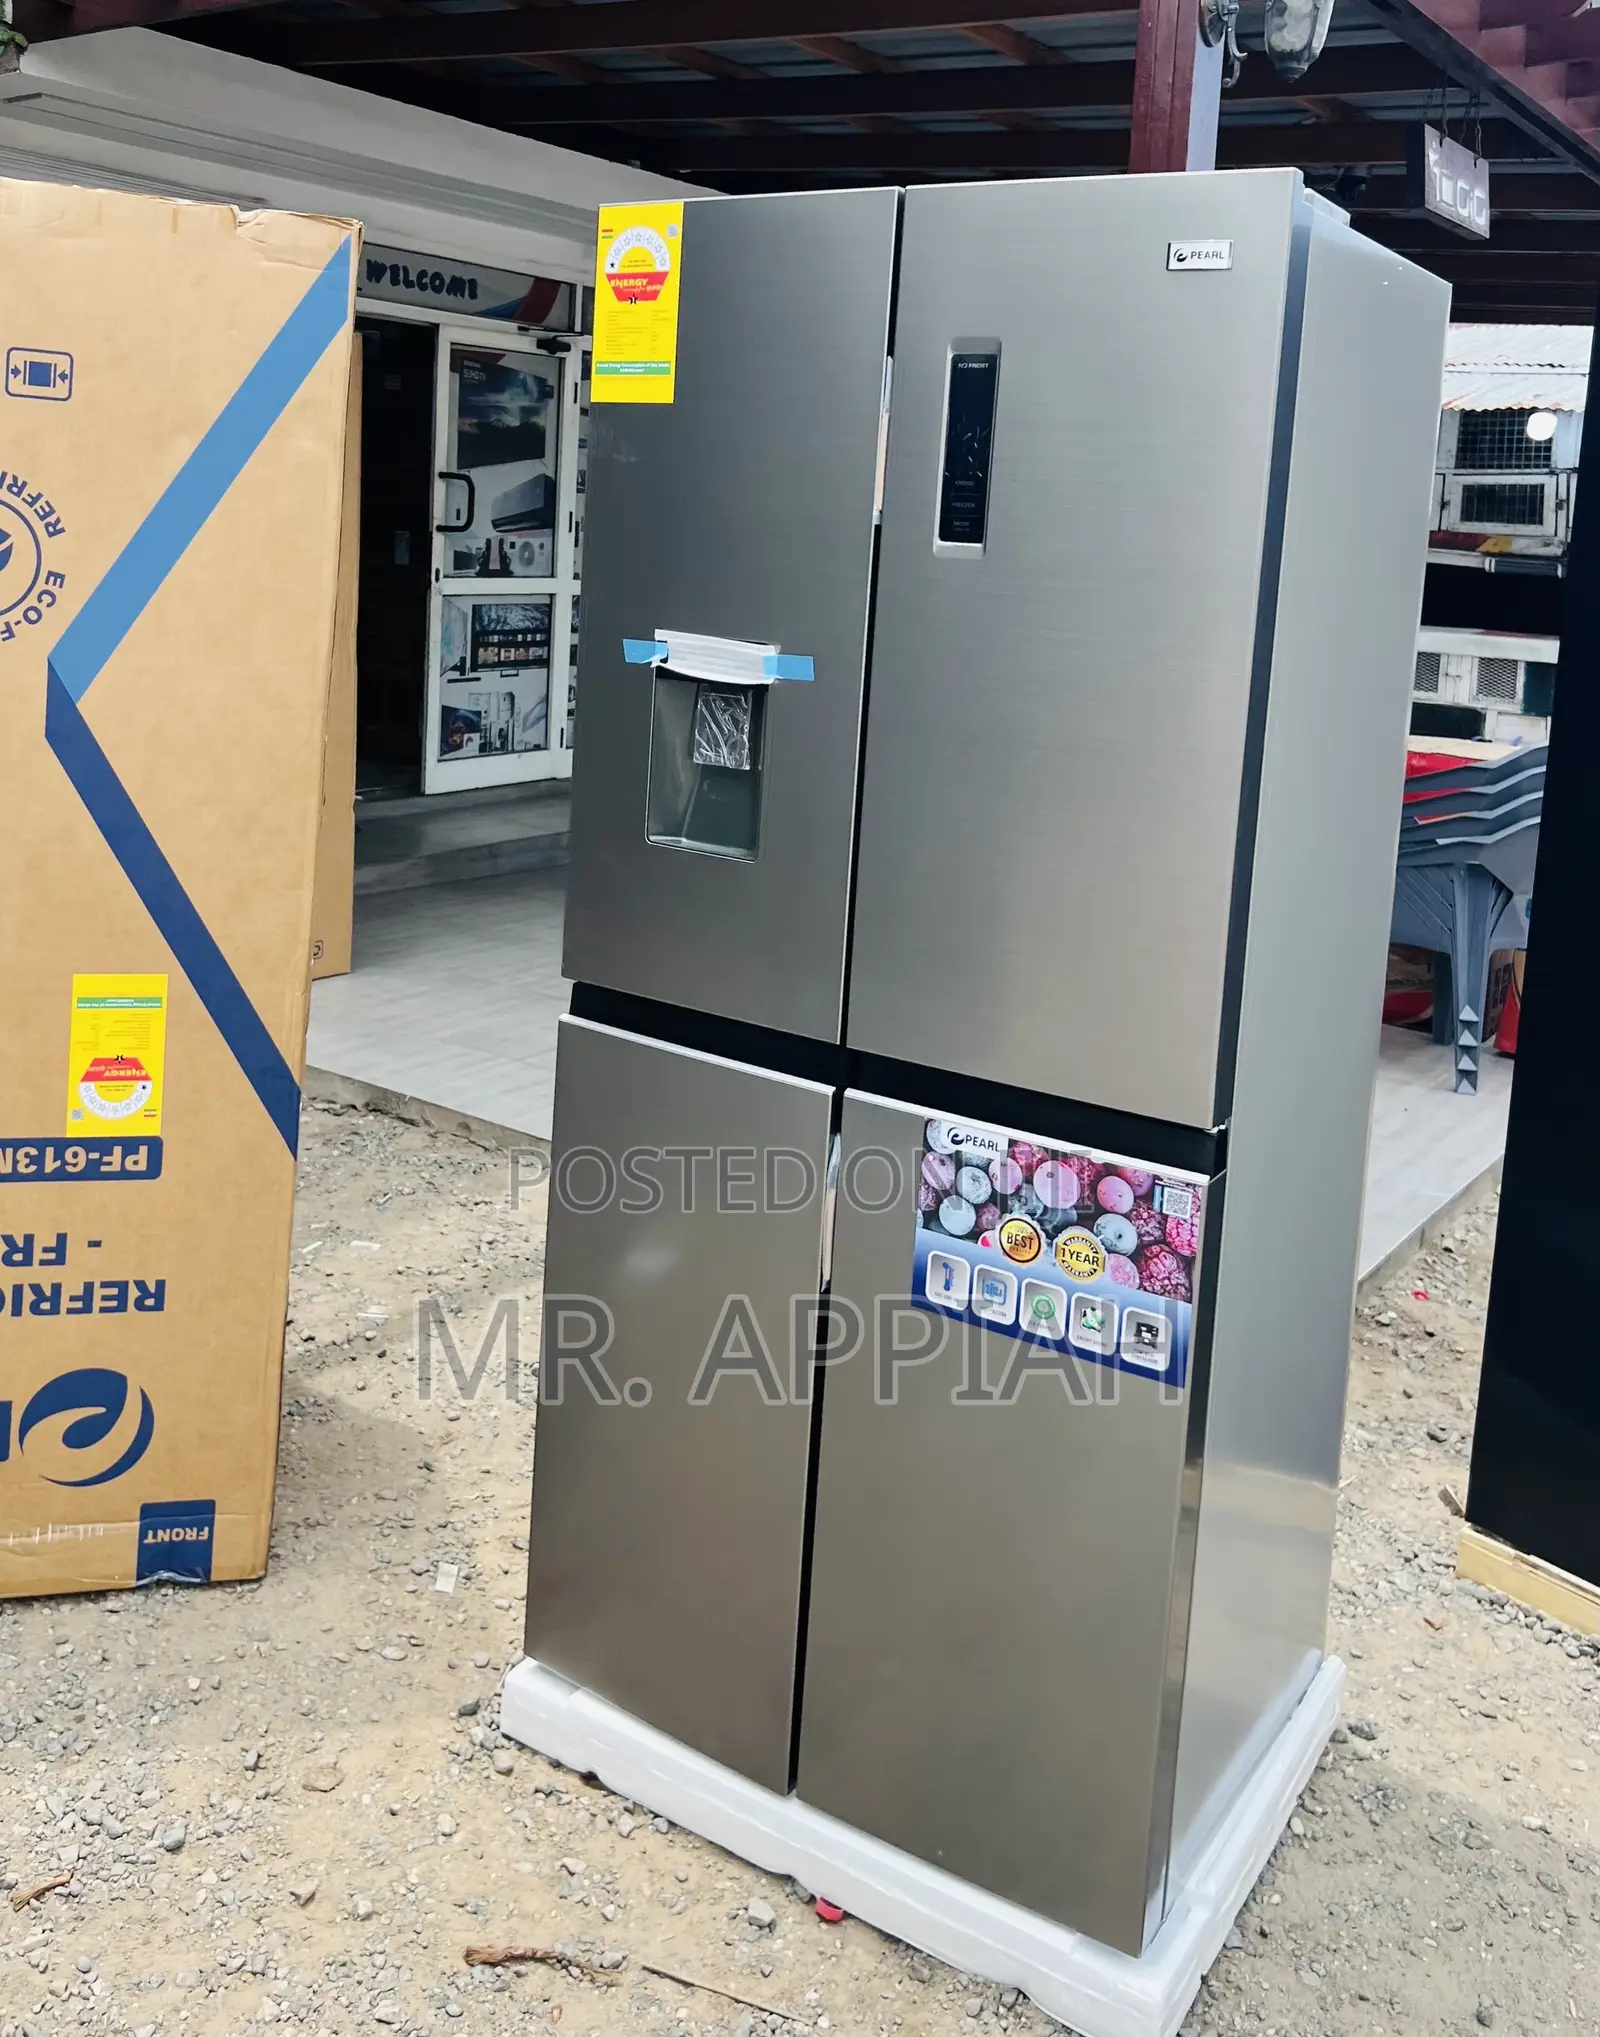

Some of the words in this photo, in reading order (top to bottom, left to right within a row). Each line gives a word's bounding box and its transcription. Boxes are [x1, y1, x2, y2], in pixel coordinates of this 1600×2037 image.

[1190, 250, 1225, 260] PEARL
[365, 258, 478, 300] WELCOME
[964, 1134, 1001, 1152] PEARL
[1007, 1231, 1034, 1250] BEST
[1060, 1247, 1066, 1258] 1
[1068, 1248, 1100, 1267] YEAR
[0, 1278, 166, 1318] REFRI
[143, 1526, 209, 1544] FRONT
